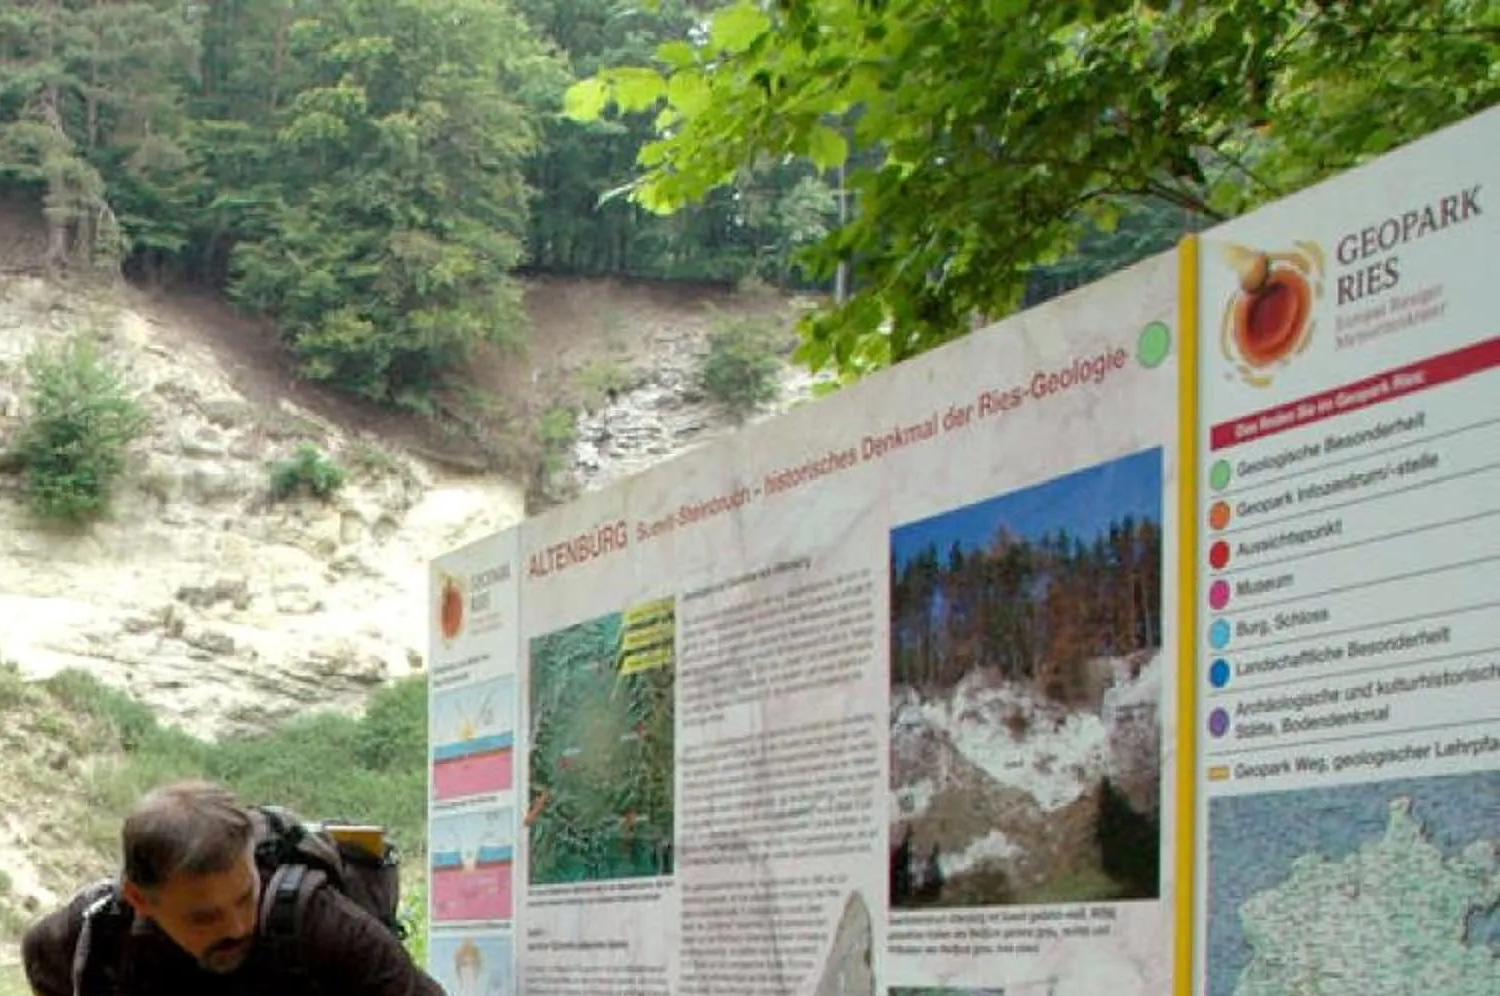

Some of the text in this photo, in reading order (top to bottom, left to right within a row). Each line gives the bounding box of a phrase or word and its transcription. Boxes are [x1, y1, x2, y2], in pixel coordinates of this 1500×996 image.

[1336, 184, 1482, 266] GEOPARK
[1336, 257, 1400, 306] RIES
[529, 519, 628, 577] ALTENBURG
[763, 447, 858, 495] historisches
[861, 411, 938, 462] Denkmal
[943, 403, 974, 431] der
[978, 347, 1127, 418] Ries-Geologie
[1236, 411, 1426, 477] Geologische Besonderheit
[1236, 488, 1293, 517] Geopark
[1236, 518, 1344, 557] Aussichtspunkt
[1236, 574, 1295, 597] Museum
[1235, 625, 1451, 677] Landschaftliche Besonderheit
[1345, 681, 1374, 699] und
[1281, 703, 1391, 734] Bodendenkmal
[1235, 758, 1291, 781] Geopark
[1332, 742, 1432, 772] geologischer
